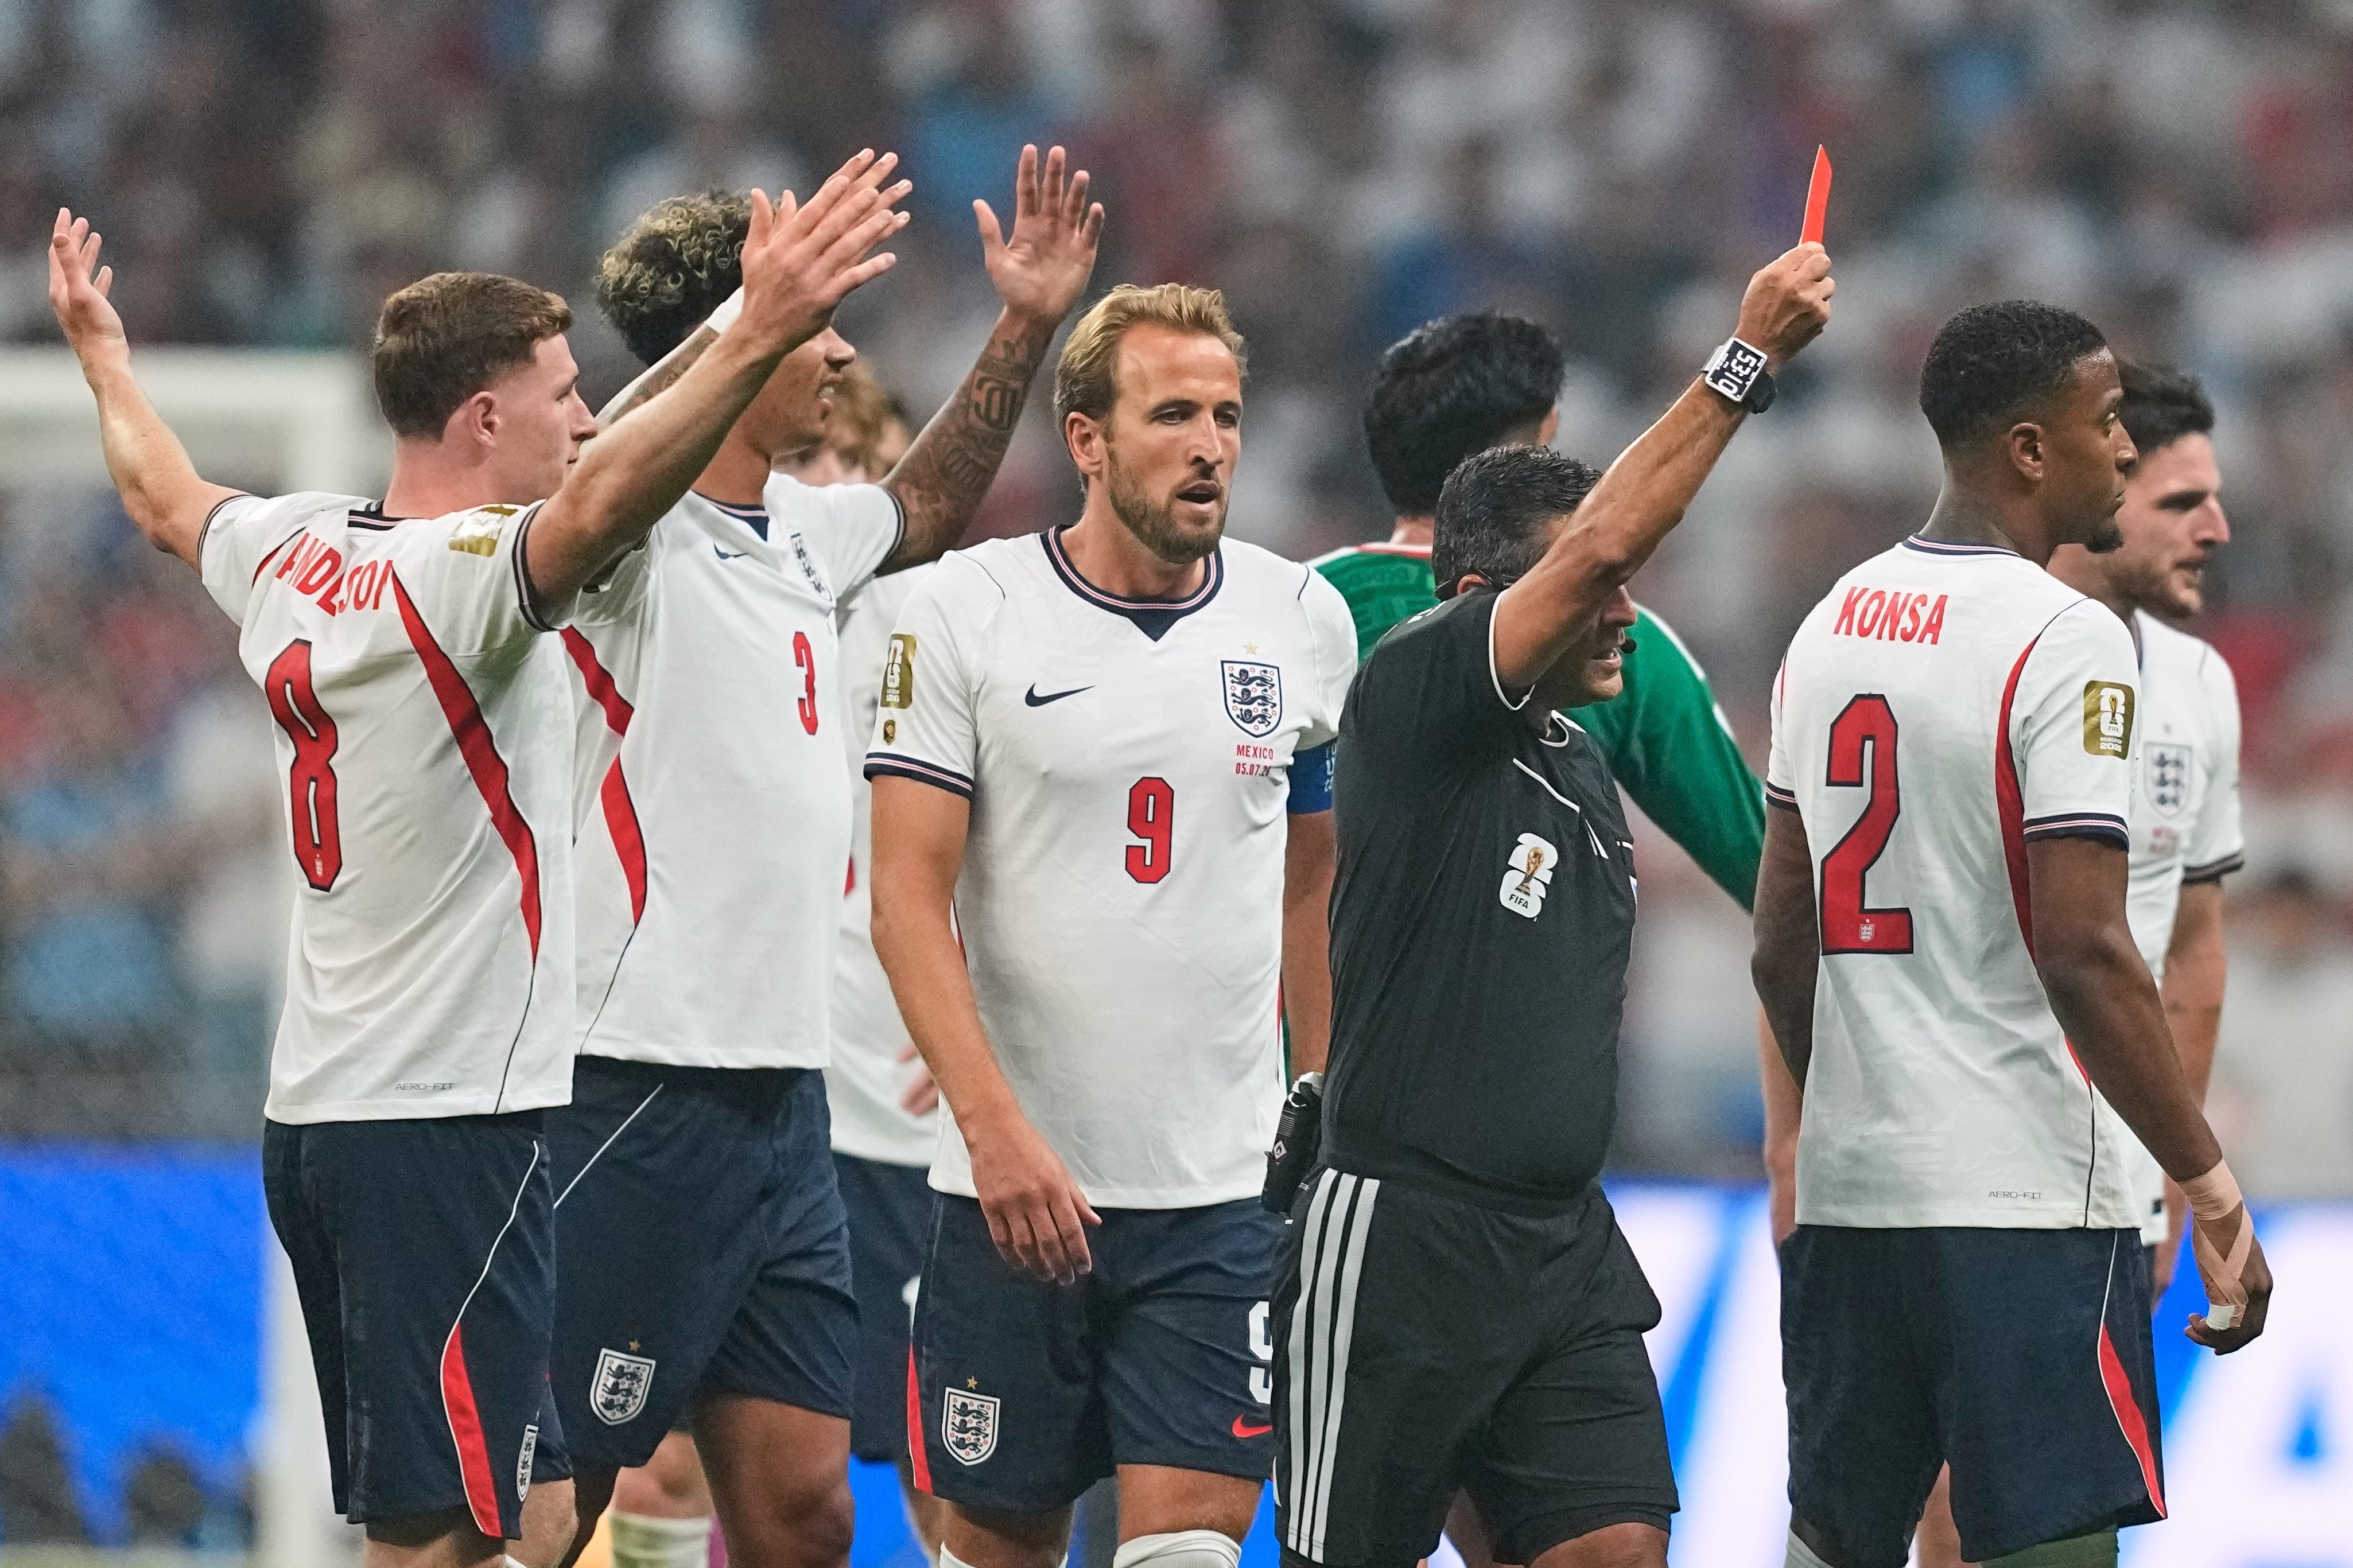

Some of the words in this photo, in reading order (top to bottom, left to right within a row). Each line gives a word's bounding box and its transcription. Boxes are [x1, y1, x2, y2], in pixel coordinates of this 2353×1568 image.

[1718, 349, 1757, 394] 53:10
[1834, 586, 1948, 645] KONSA
[793, 631, 818, 736] 3
[265, 637, 343, 893] 8
[1237, 745, 1273, 760] MEXICO
[1125, 776, 1174, 884] 9
[1820, 694, 1914, 956] 2
[1508, 894, 1529, 909] FIFA
[395, 1083, 456, 1091] AERO-FIT
[1989, 1191, 2043, 1199] AERO-FIT
